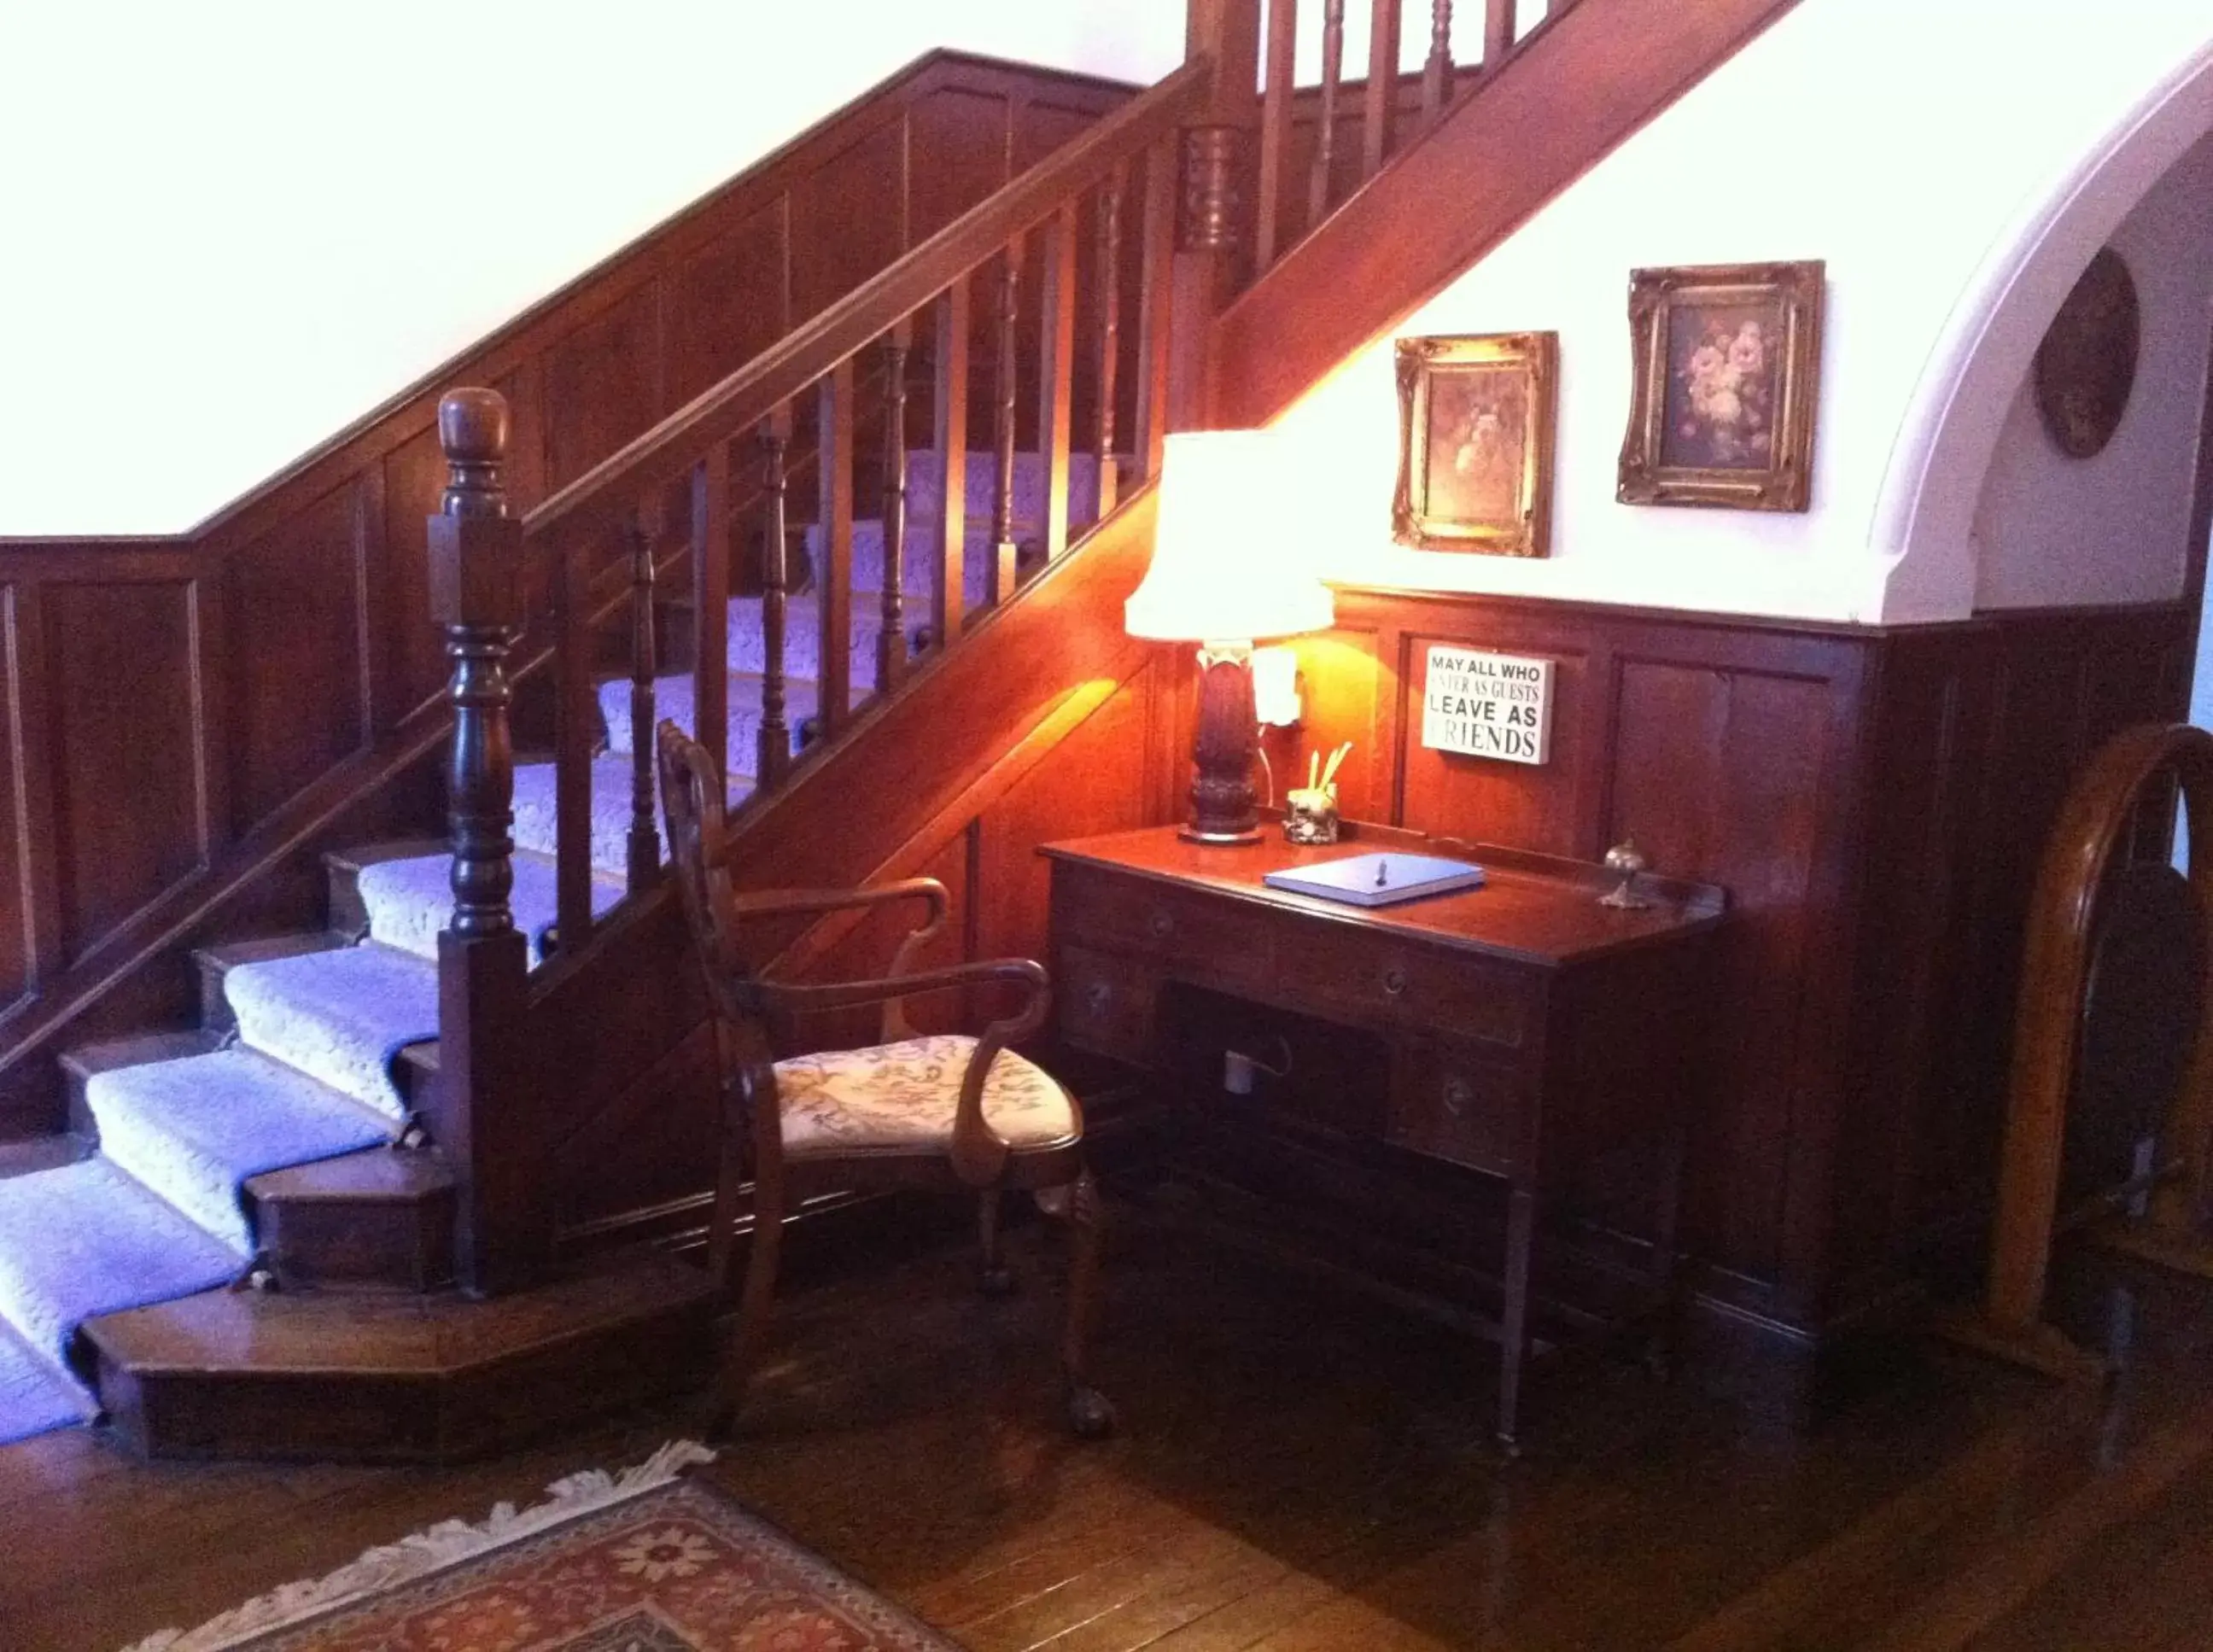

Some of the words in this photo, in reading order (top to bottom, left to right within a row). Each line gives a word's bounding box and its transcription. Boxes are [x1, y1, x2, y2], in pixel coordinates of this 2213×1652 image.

[1432, 656, 1464, 671] MAY
[1467, 660, 1497, 677] ALL
[1501, 663, 1540, 682] WHO
[1432, 673, 1469, 694] NTER
[1474, 680, 1488, 696] AS
[1492, 681, 1539, 703] GUESTS
[1430, 694, 1496, 721] LEAVE
[1507, 705, 1537, 727] AS
[1430, 718, 1535, 757] RIENDS
